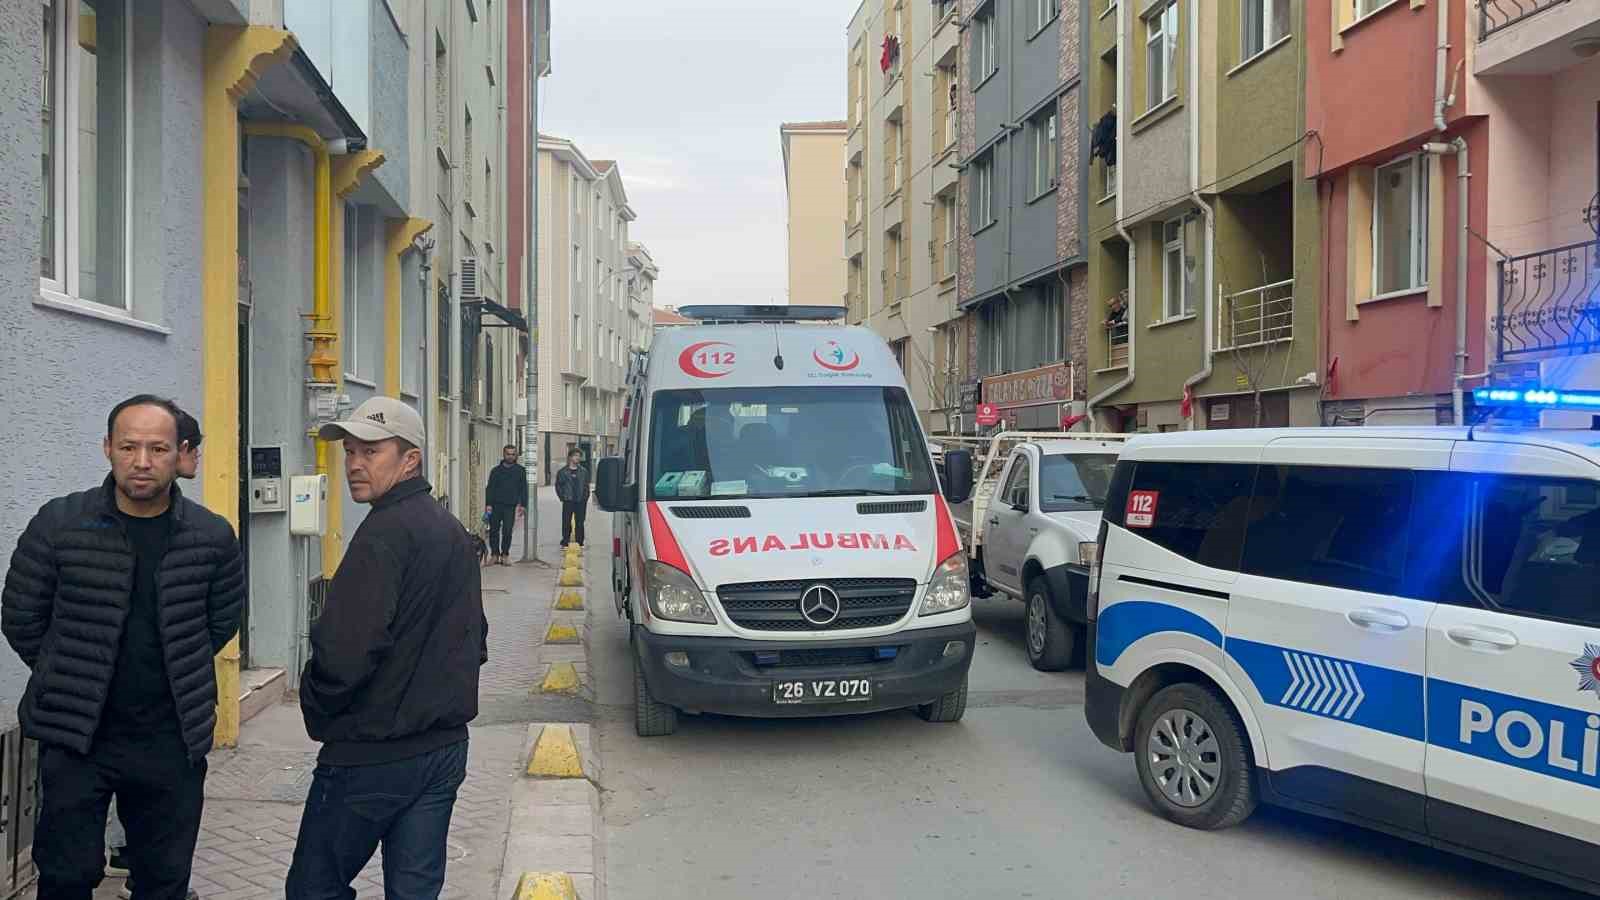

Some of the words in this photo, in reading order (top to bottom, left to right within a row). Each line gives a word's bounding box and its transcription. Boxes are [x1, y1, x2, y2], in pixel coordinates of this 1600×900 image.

[697, 352, 736, 365] 112
[1132, 494, 1153, 512] 112
[783, 681, 804, 698] 26
[812, 680, 836, 697] VZ
[839, 679, 870, 696] 070
